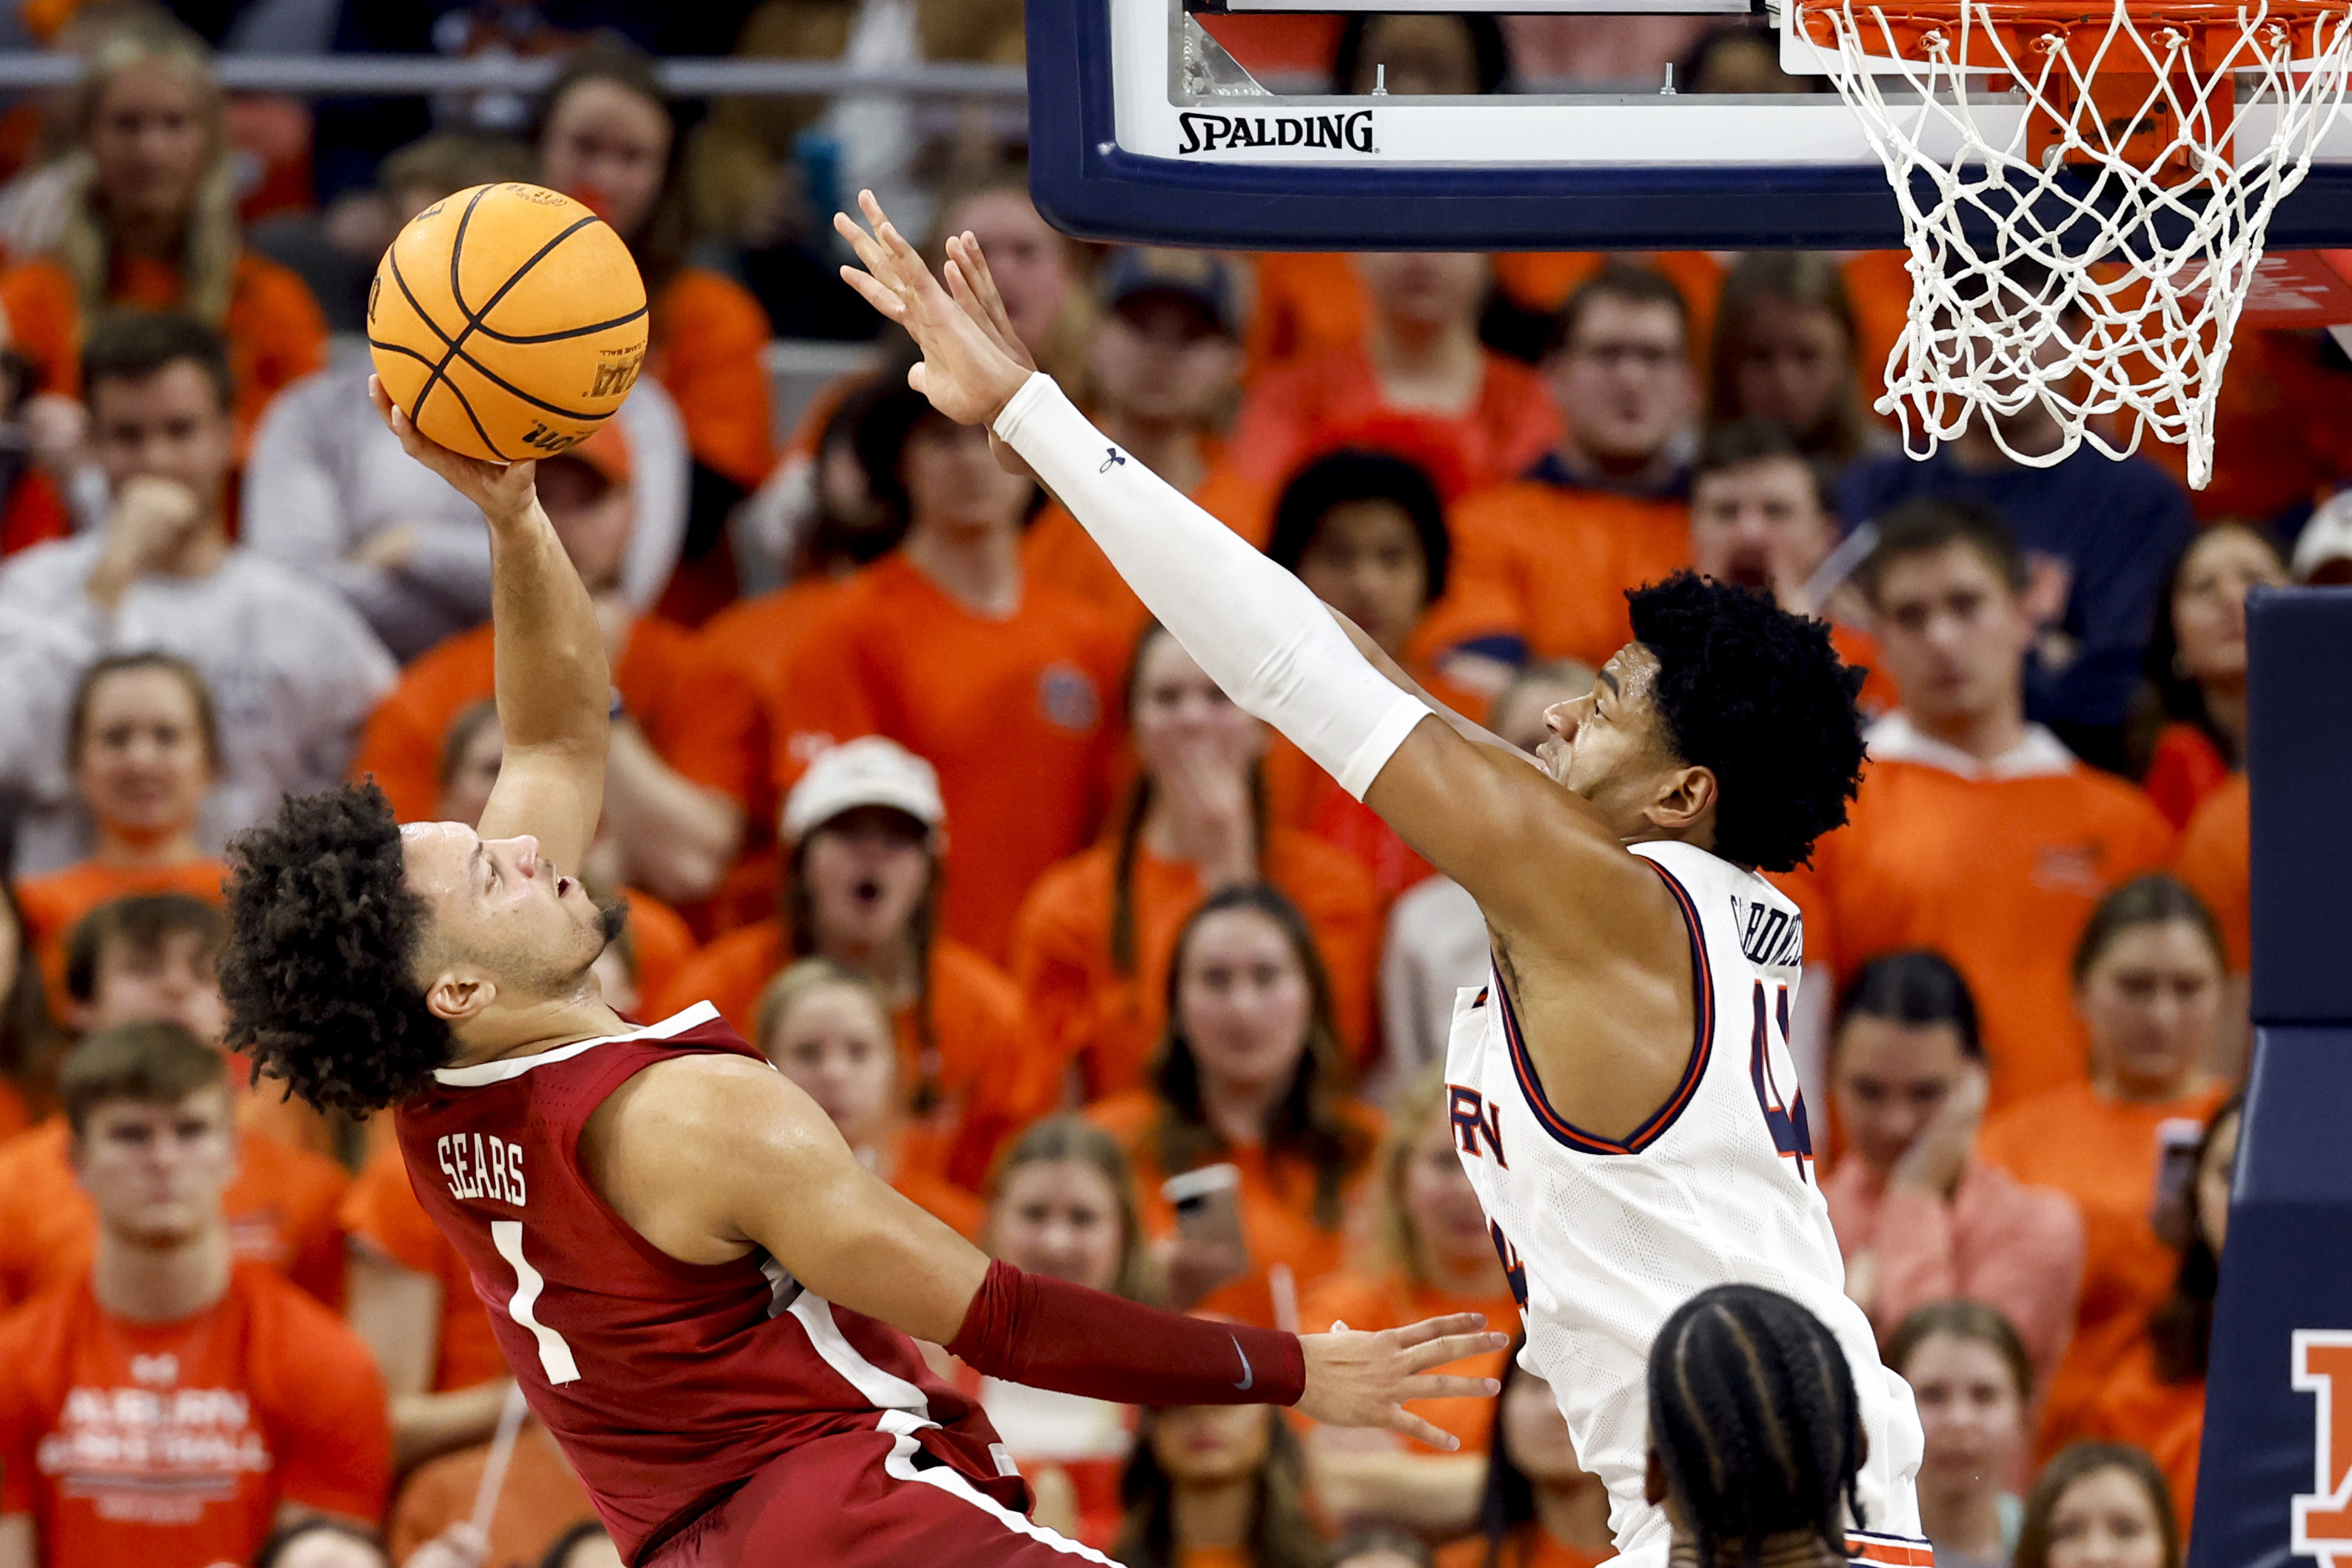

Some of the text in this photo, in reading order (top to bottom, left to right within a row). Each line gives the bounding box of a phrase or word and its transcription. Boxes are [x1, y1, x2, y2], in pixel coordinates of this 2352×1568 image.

[1179, 110, 1373, 155] SPALDING
[438, 1133, 526, 1207] SEARS
[491, 1220, 582, 1386] 1
